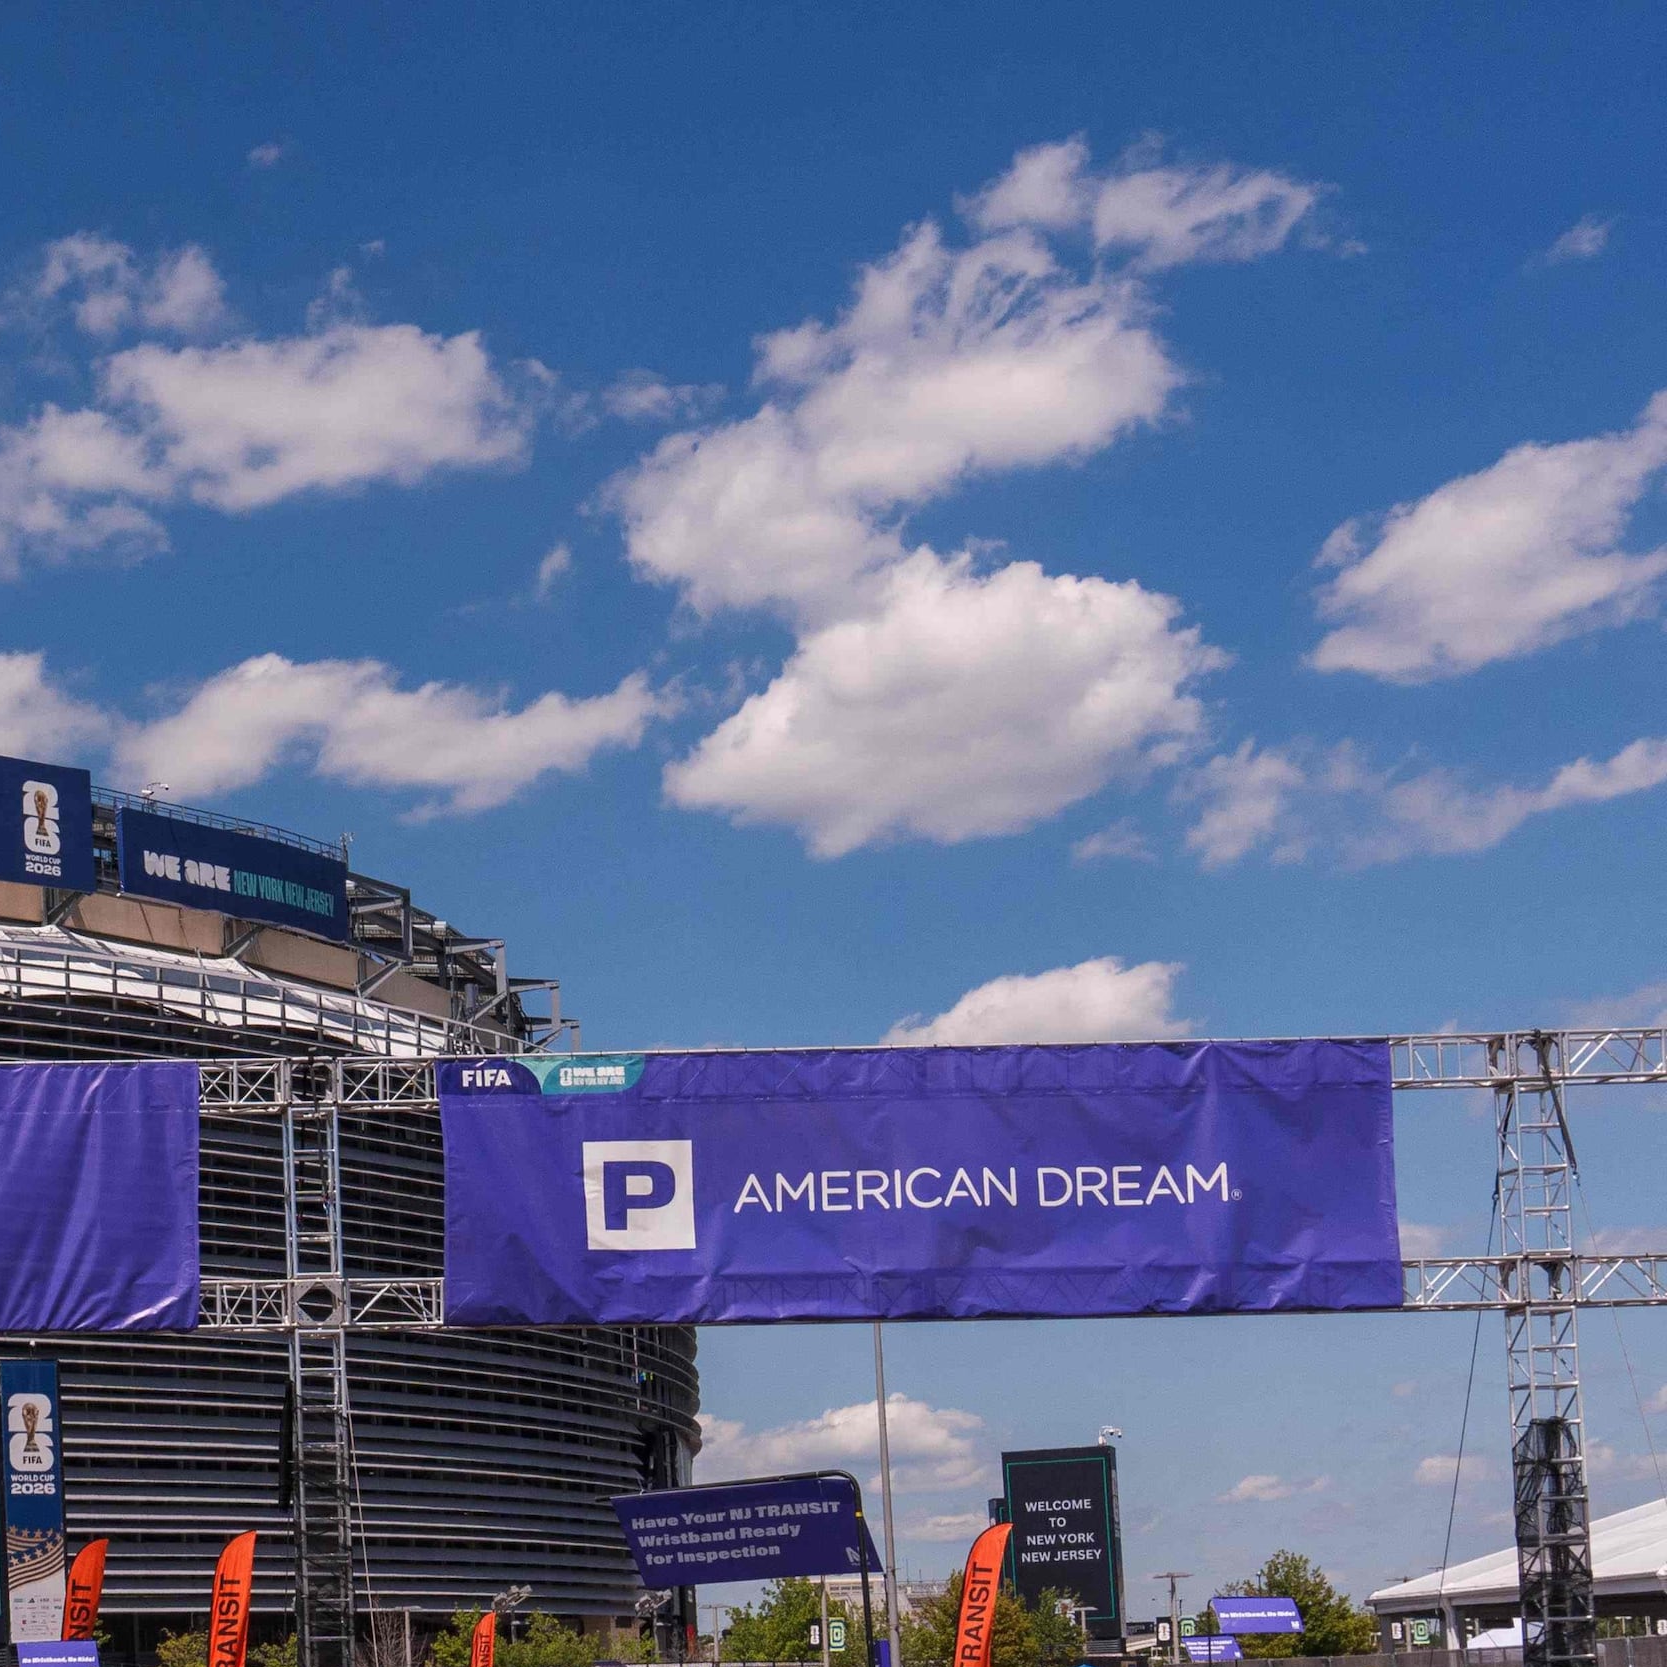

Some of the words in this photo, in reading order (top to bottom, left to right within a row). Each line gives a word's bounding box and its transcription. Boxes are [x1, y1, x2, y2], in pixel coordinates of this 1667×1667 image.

[35, 839, 51, 848] FIFA
[25, 853, 48, 863] WORLD
[49, 857, 61, 865] CUP
[25, 862, 61, 877] 2026
[143, 850, 181, 881] WE
[184, 859, 230, 892] ARE
[233, 870, 257, 898] NEW
[258, 873, 285, 904] YORK
[285, 881, 305, 908] NEW
[305, 888, 335, 917] JERSEY
[462, 1070, 511, 1087] FIFA
[603, 1160, 676, 1231] P
[733, 1167, 1019, 1214] AMERICAN
[23, 1456, 42, 1464] FIFA
[11, 1474, 38, 1482] WORLD
[39, 1474, 55, 1482] CUP
[11, 1483, 56, 1495] 2026
[1025, 1499, 1092, 1512] WELCOME
[631, 1516, 679, 1530] Have
[681, 1511, 727, 1525] Your
[729, 1508, 752, 1521] NJ
[755, 1501, 841, 1518] TRANSIT
[1049, 1517, 1067, 1528] TO
[638, 1528, 736, 1548] Wristband
[740, 1523, 802, 1539] Ready
[1026, 1534, 1057, 1546] NEW
[1059, 1532, 1095, 1544] YORK
[645, 1551, 673, 1566] for
[677, 1545, 781, 1564] Inspection
[1021, 1551, 1052, 1563] NEW
[1054, 1549, 1102, 1562] JERSEY
